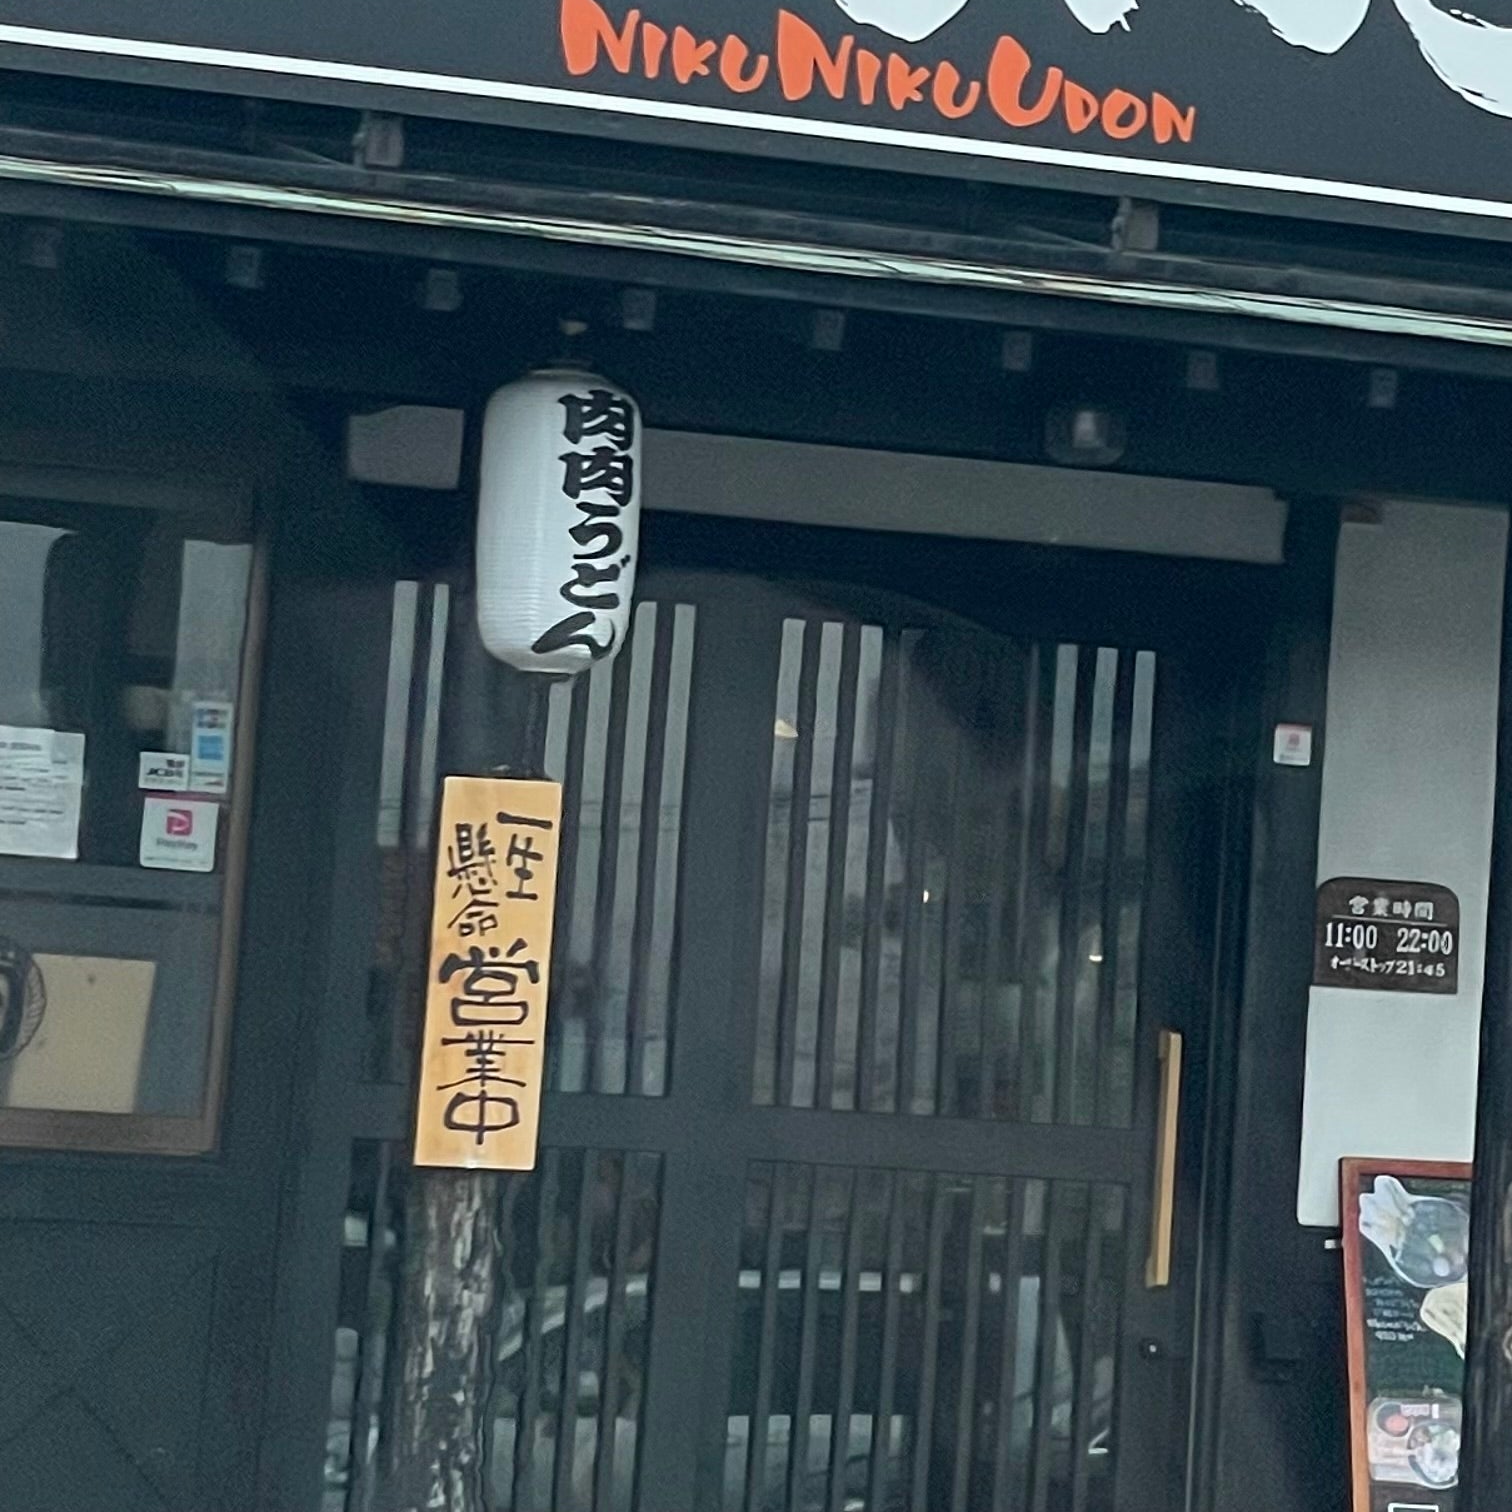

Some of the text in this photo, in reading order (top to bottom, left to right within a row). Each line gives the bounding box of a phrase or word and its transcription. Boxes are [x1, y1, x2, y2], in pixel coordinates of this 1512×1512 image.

[532, 389, 635, 660] 肉肉うどん
[437, 937, 540, 1146] 営業中
[1325, 922, 1453, 955] 11:00 22:00
